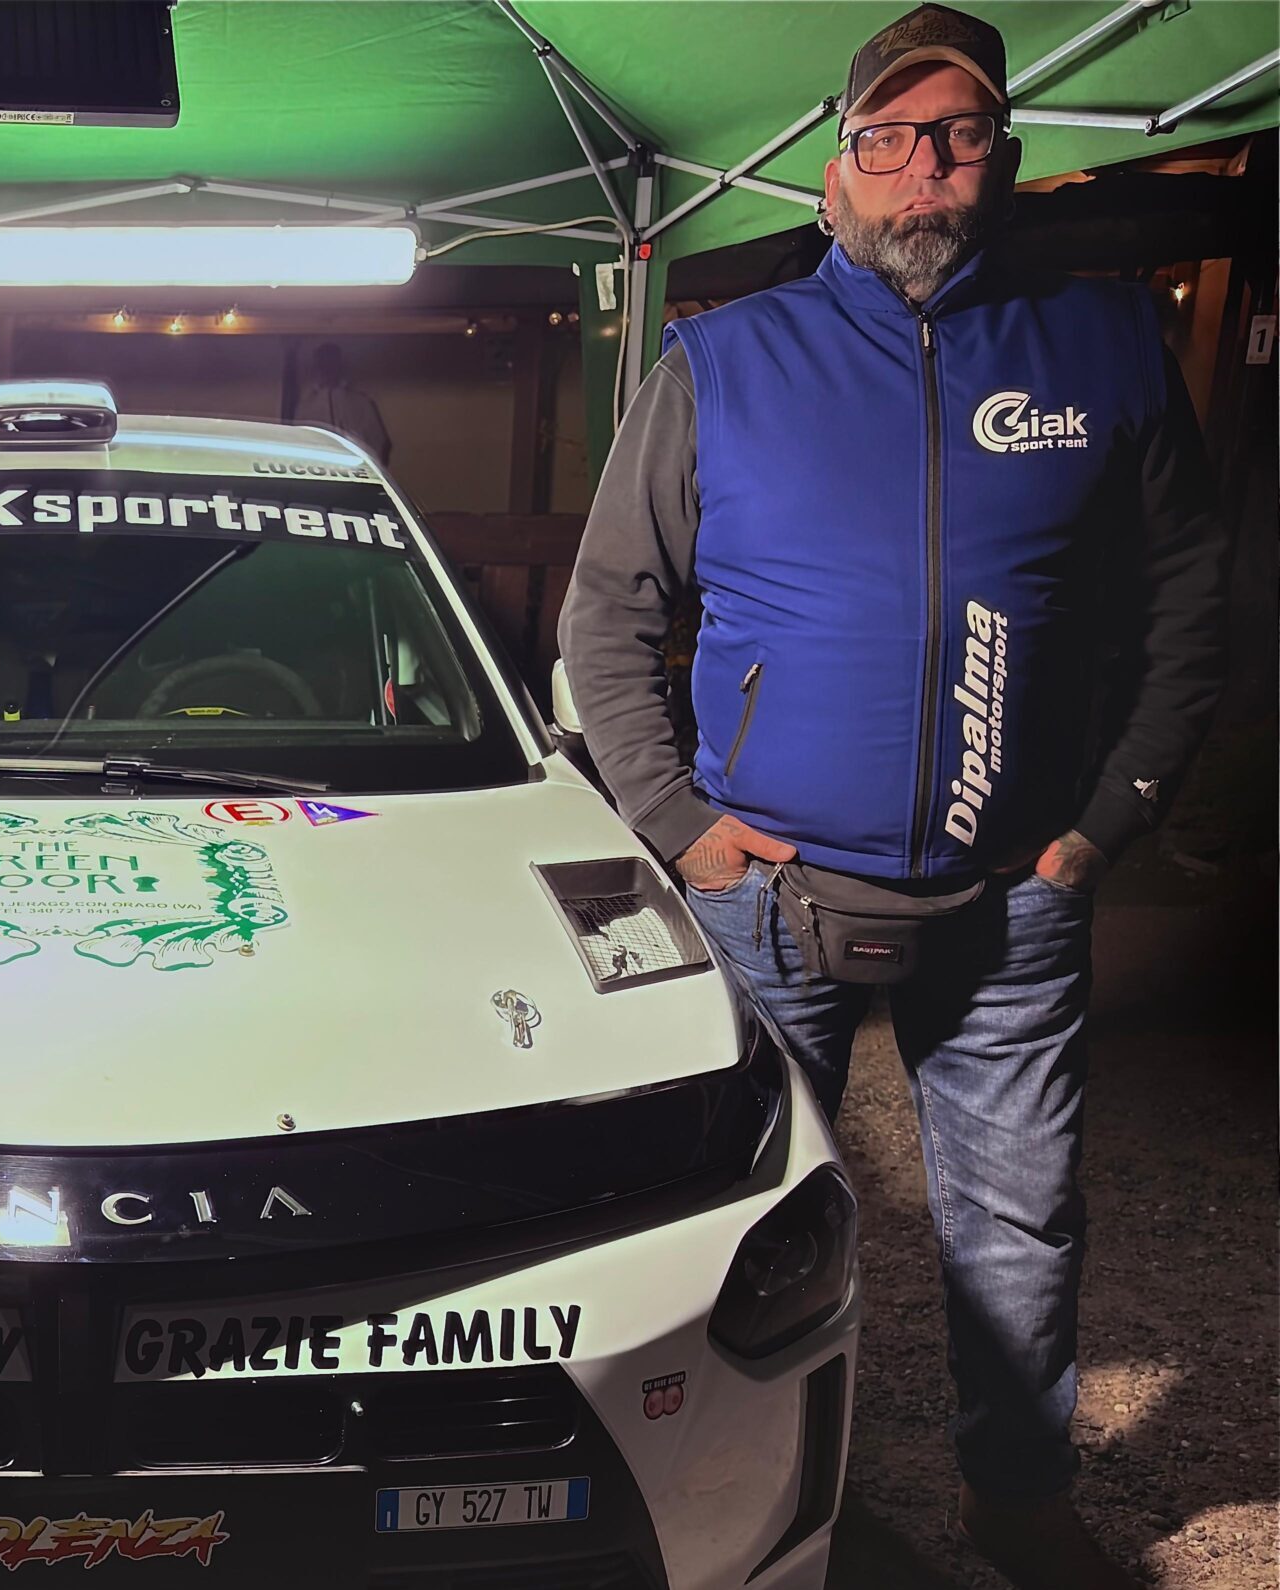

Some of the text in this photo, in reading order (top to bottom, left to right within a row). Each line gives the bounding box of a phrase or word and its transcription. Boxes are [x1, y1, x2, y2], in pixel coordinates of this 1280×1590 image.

[1256, 328, 1267, 353] 1
[972, 391, 1088, 453] Giak
[1010, 438, 1089, 453] sport rent
[32, 494, 406, 550] sportrent
[987, 610, 1009, 774] motorsport
[944, 600, 993, 848] Dipalma
[222, 803, 274, 821] E
[13, 840, 80, 852] THE
[173, 903, 203, 911] (VA)
[123, 1314, 344, 1379] GRAZIE
[366, 1304, 582, 1368] FAMILY
[415, 1491, 446, 1526] GY
[462, 1488, 507, 1523] 527
[523, 1484, 553, 1519] TW
